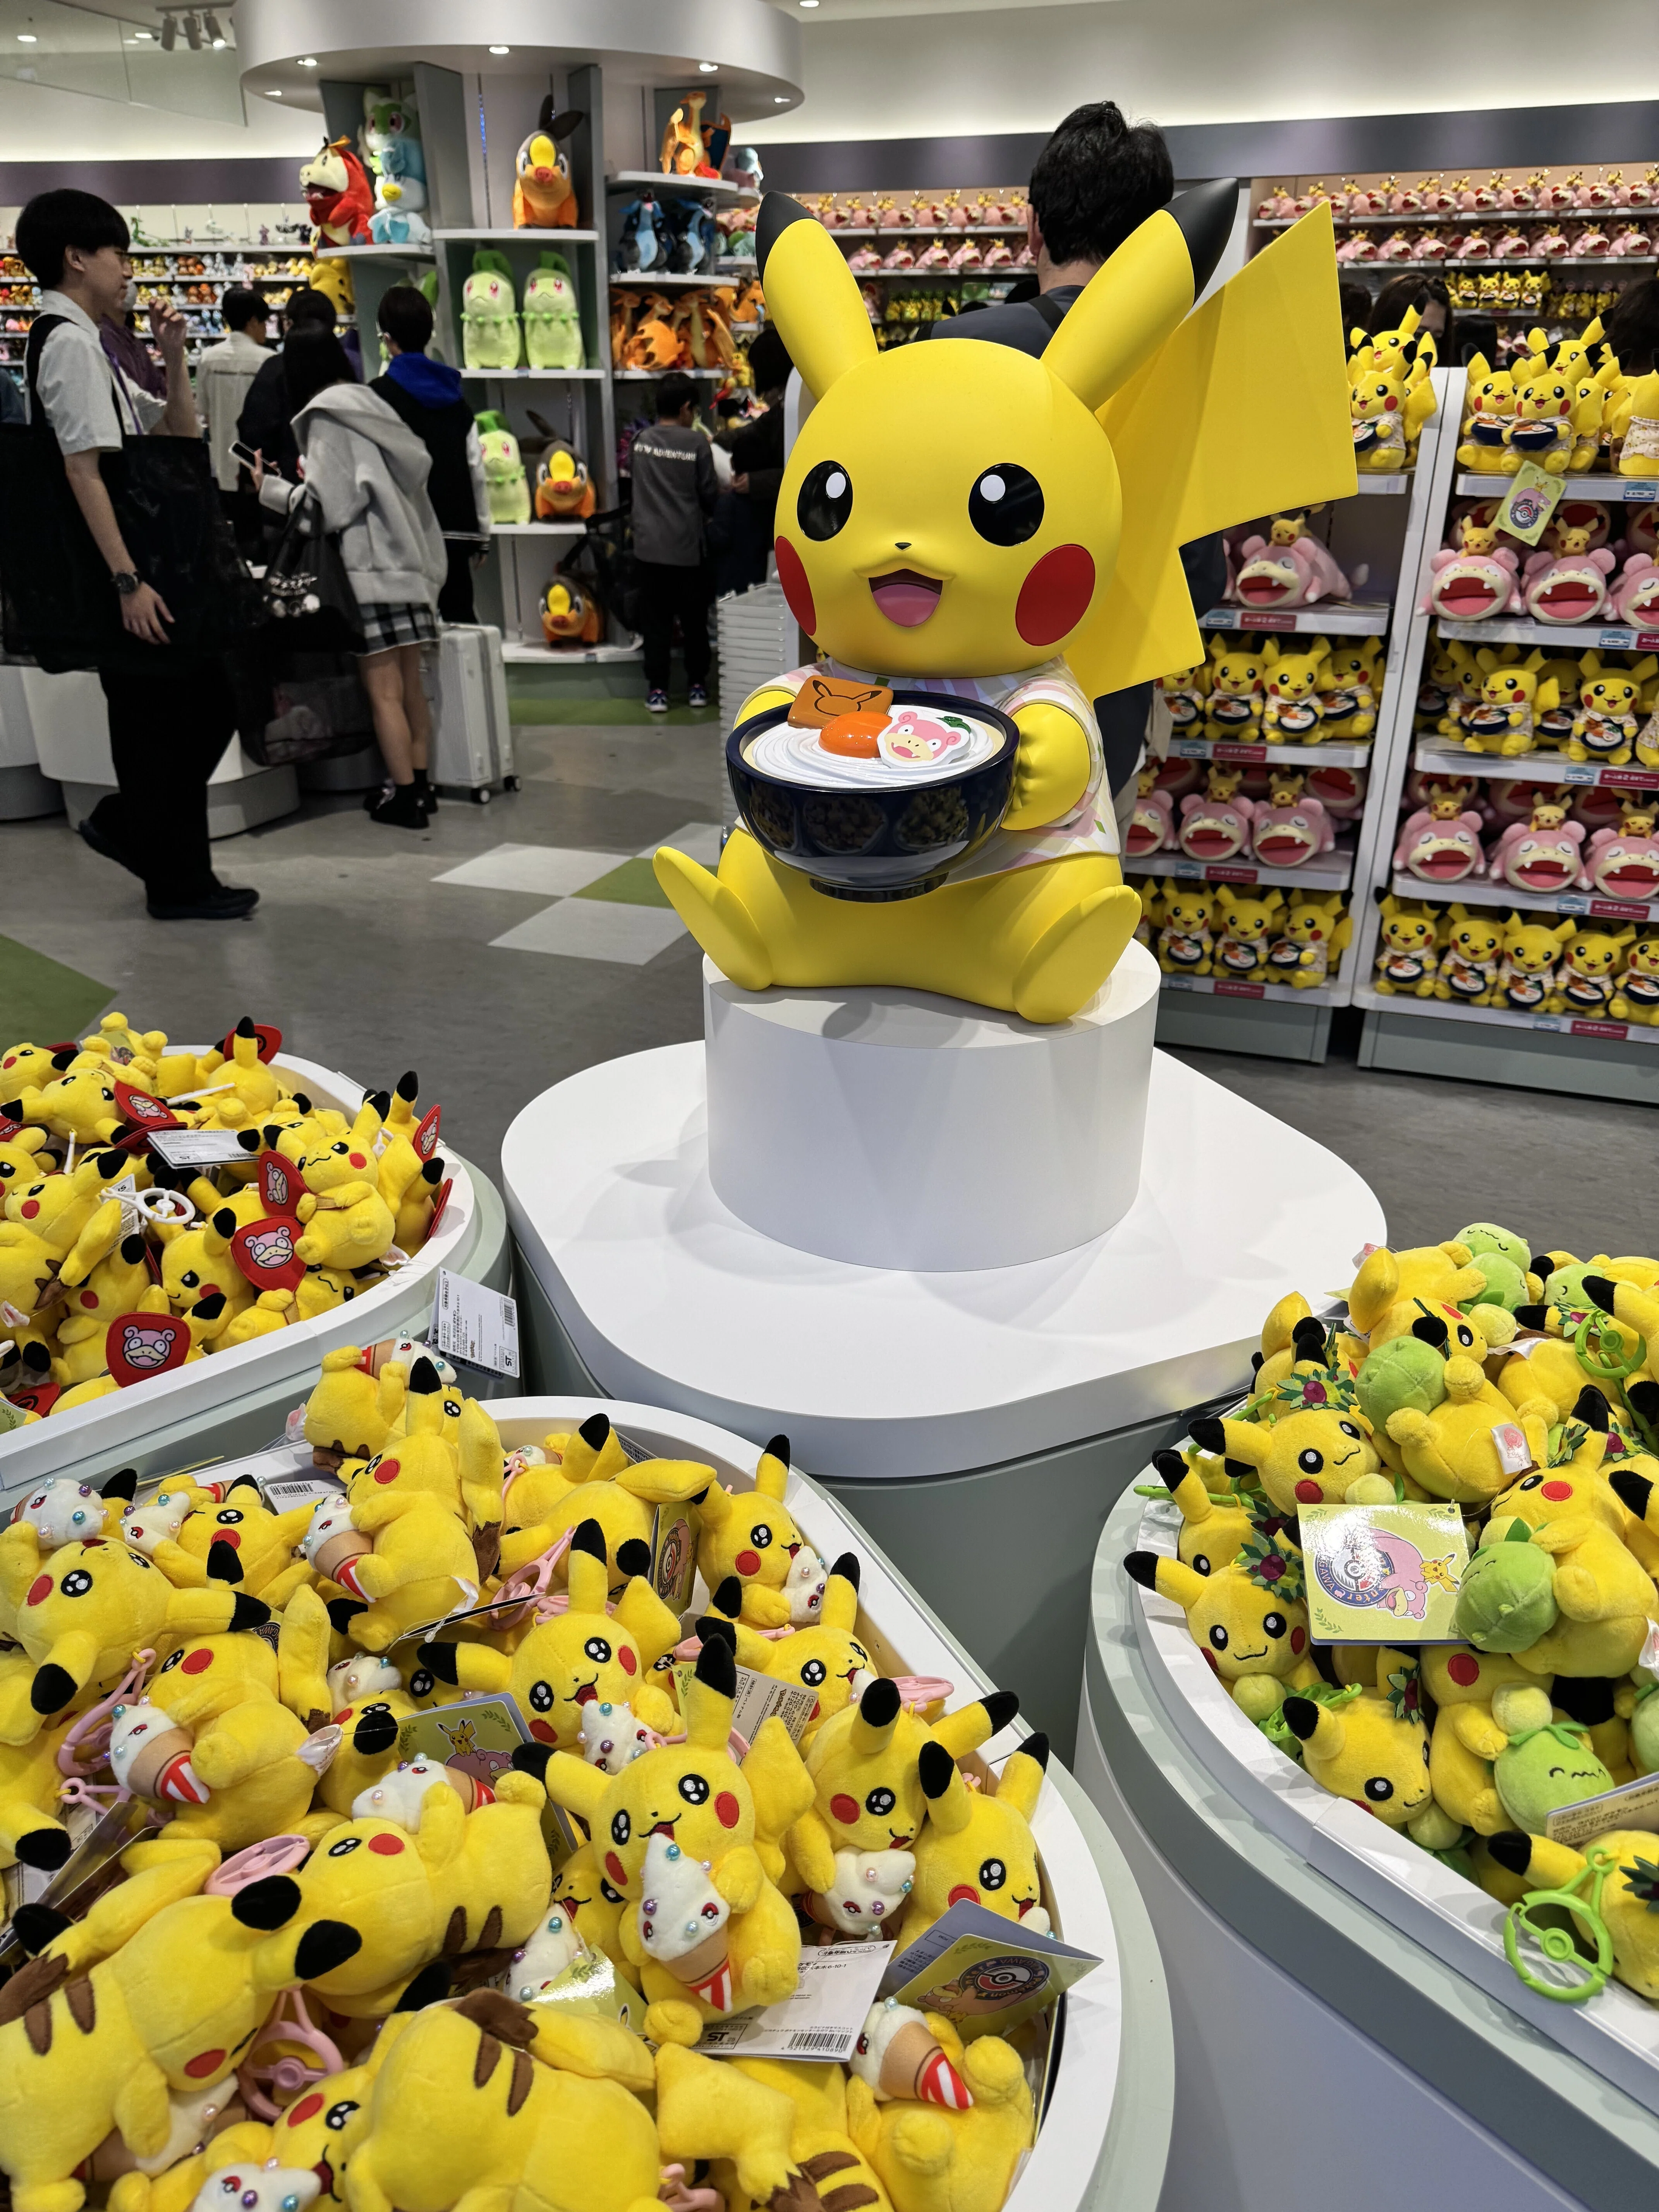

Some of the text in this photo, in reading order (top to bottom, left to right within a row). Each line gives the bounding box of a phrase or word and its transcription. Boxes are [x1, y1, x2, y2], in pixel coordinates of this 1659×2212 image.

[505, 1355, 512, 1367] ST
[1318, 1561, 1335, 1590] GAWA
[1347, 1589, 1379, 1602] nter
[783, 1692, 797, 1719] 0120-049-
[965, 1965, 984, 1984] nter
[707, 2032, 730, 2042] ST
